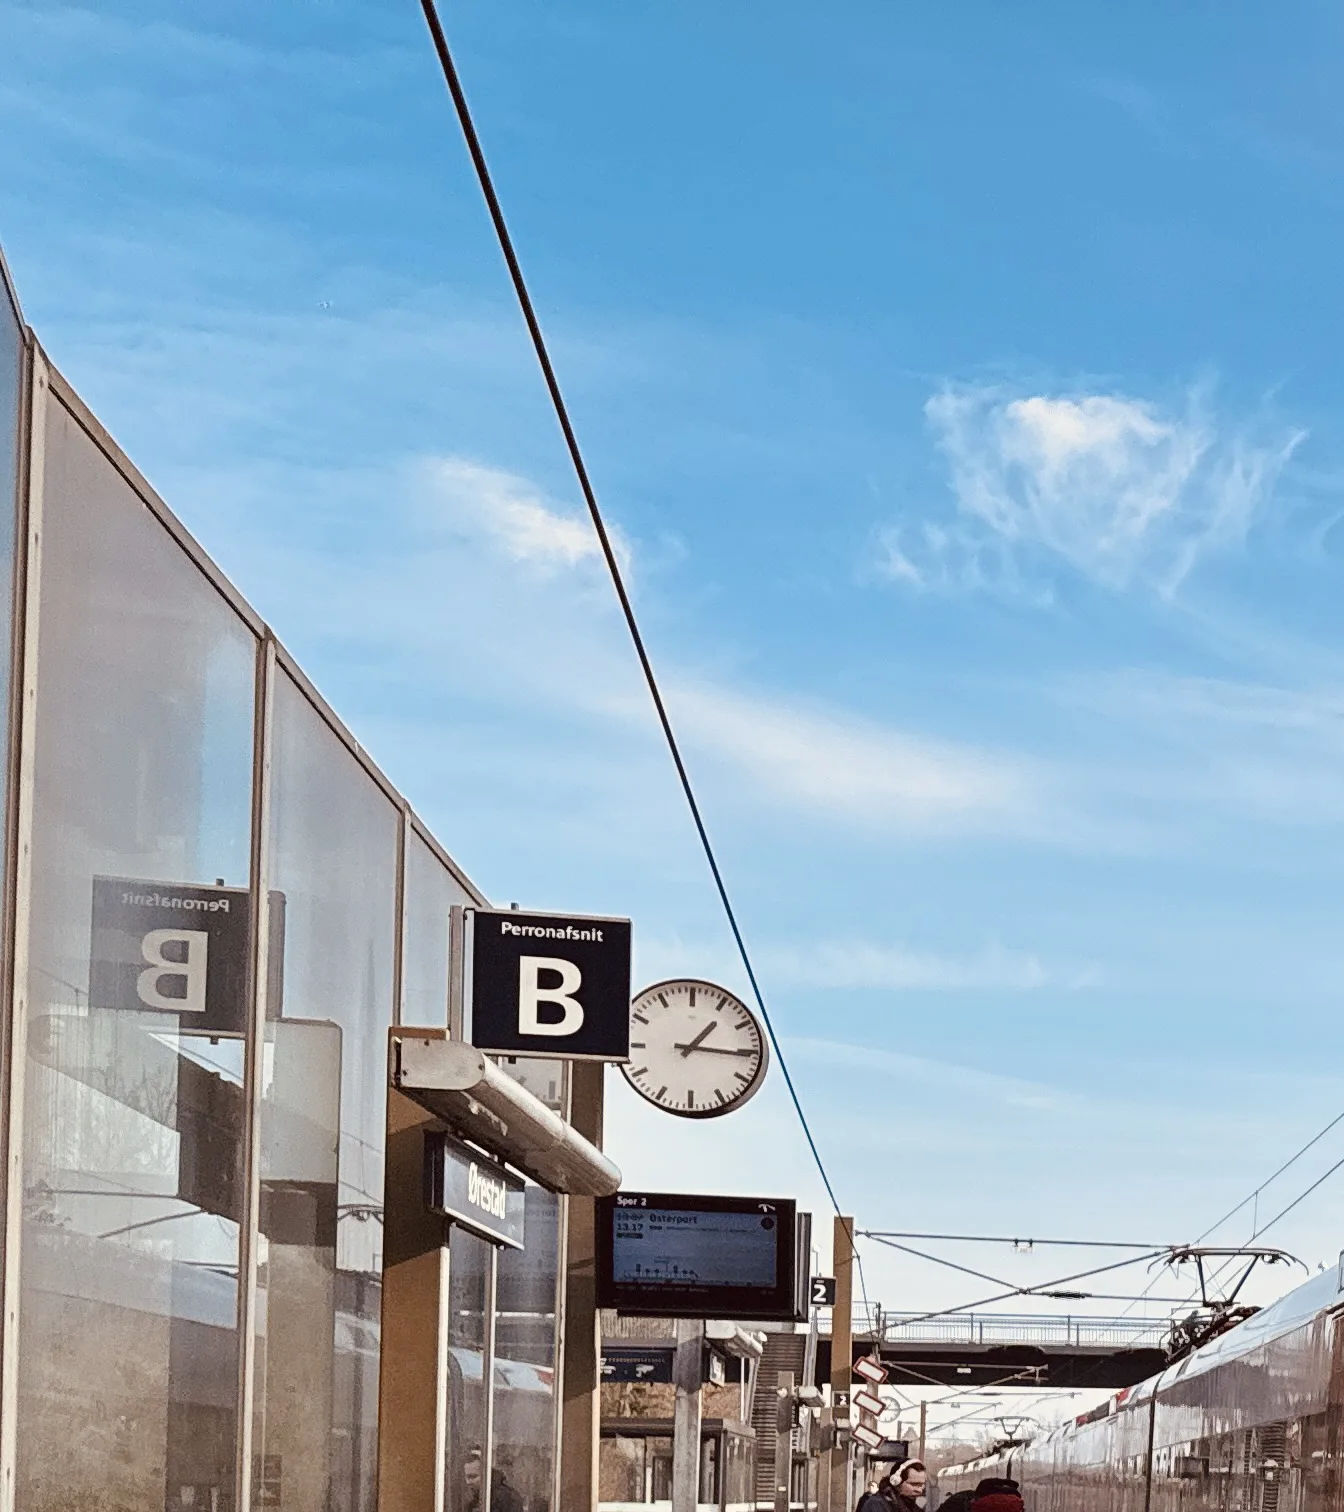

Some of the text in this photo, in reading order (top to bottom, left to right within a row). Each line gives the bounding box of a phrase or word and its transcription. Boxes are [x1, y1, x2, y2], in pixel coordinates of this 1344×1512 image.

[501, 921, 604, 942] Perronafsnit
[518, 955, 585, 1036] B
[468, 1161, 506, 1220] Ørestad
[640, 1197, 647, 1207] 2
[812, 1284, 827, 1303] 2
